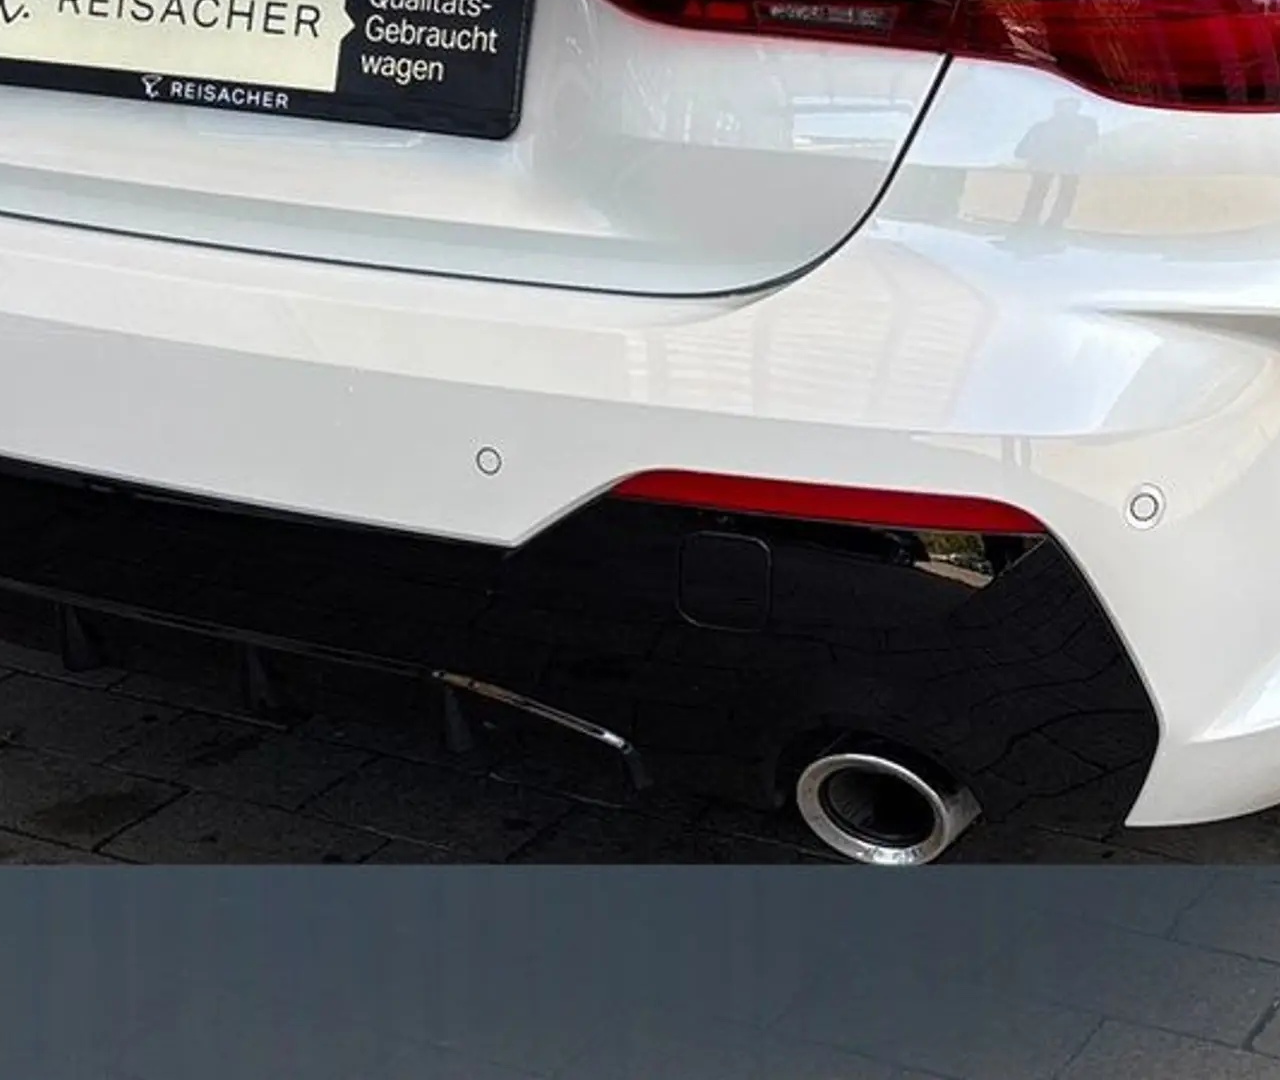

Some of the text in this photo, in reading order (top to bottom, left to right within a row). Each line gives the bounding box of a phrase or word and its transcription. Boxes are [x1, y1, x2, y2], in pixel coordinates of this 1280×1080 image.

[365, 14, 498, 53] Gebraucht
[361, 54, 444, 84] wagen
[170, 81, 289, 110] REISACHER
